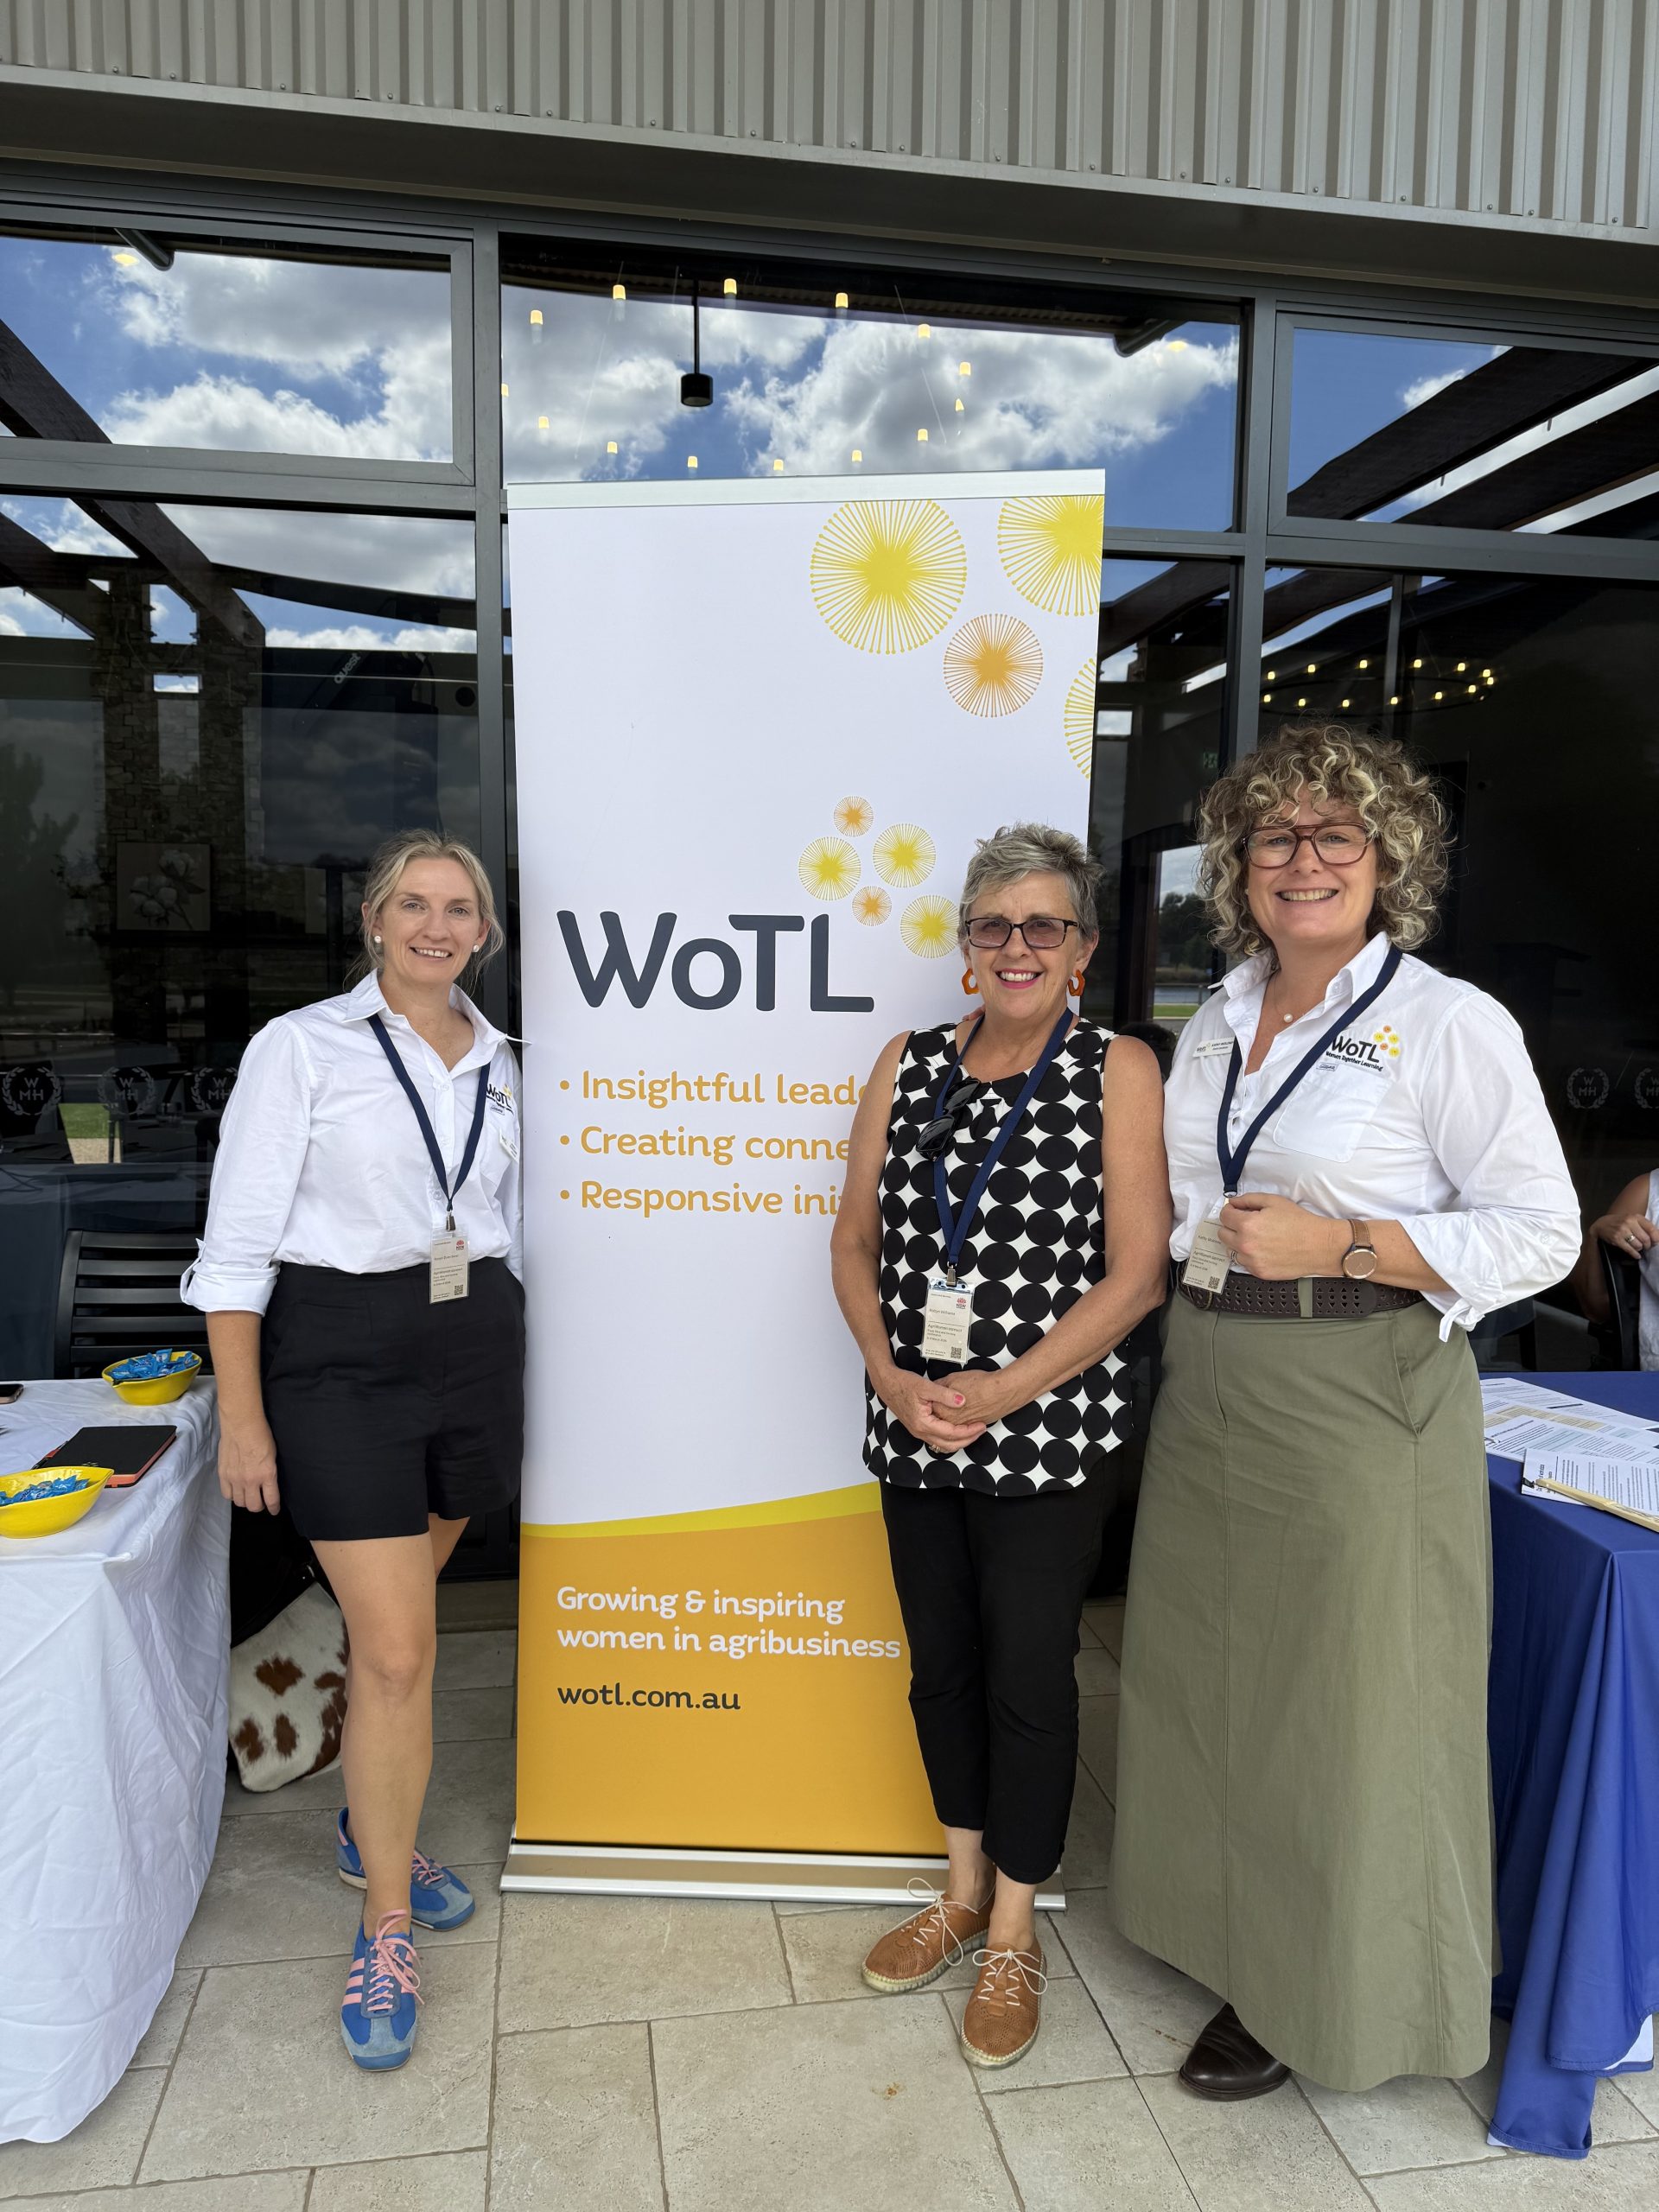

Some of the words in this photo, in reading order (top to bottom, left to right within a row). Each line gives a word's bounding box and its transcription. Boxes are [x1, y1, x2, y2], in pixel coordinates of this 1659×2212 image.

[556, 910, 874, 1013] WoTL
[1332, 1035, 1380, 1064] WoTL
[1341, 1054, 1362, 1066] Together
[1360, 1059, 1384, 1072] Learning
[19, 1089, 44, 1101] MH
[23, 1077, 39, 1089] W
[114, 1089, 139, 1101] MH
[119, 1077, 134, 1089] W
[212, 1077, 227, 1088] W
[486, 1083, 512, 1109] WoTL
[582, 1070, 766, 1109] Insightful
[581, 1126, 736, 1166] Creating
[744, 1136, 849, 1162] conne
[581, 1180, 784, 1218] Responsive
[793, 1185, 841, 1216] ini
[556, 1586, 679, 1620] Growing
[685, 1590, 706, 1614] &
[714, 1590, 846, 1625] inspiring
[556, 1629, 665, 1651] women
[674, 1625, 702, 1652] in
[709, 1630, 901, 1660] agribusiness
[557, 1682, 741, 1711] wotl.com.au
